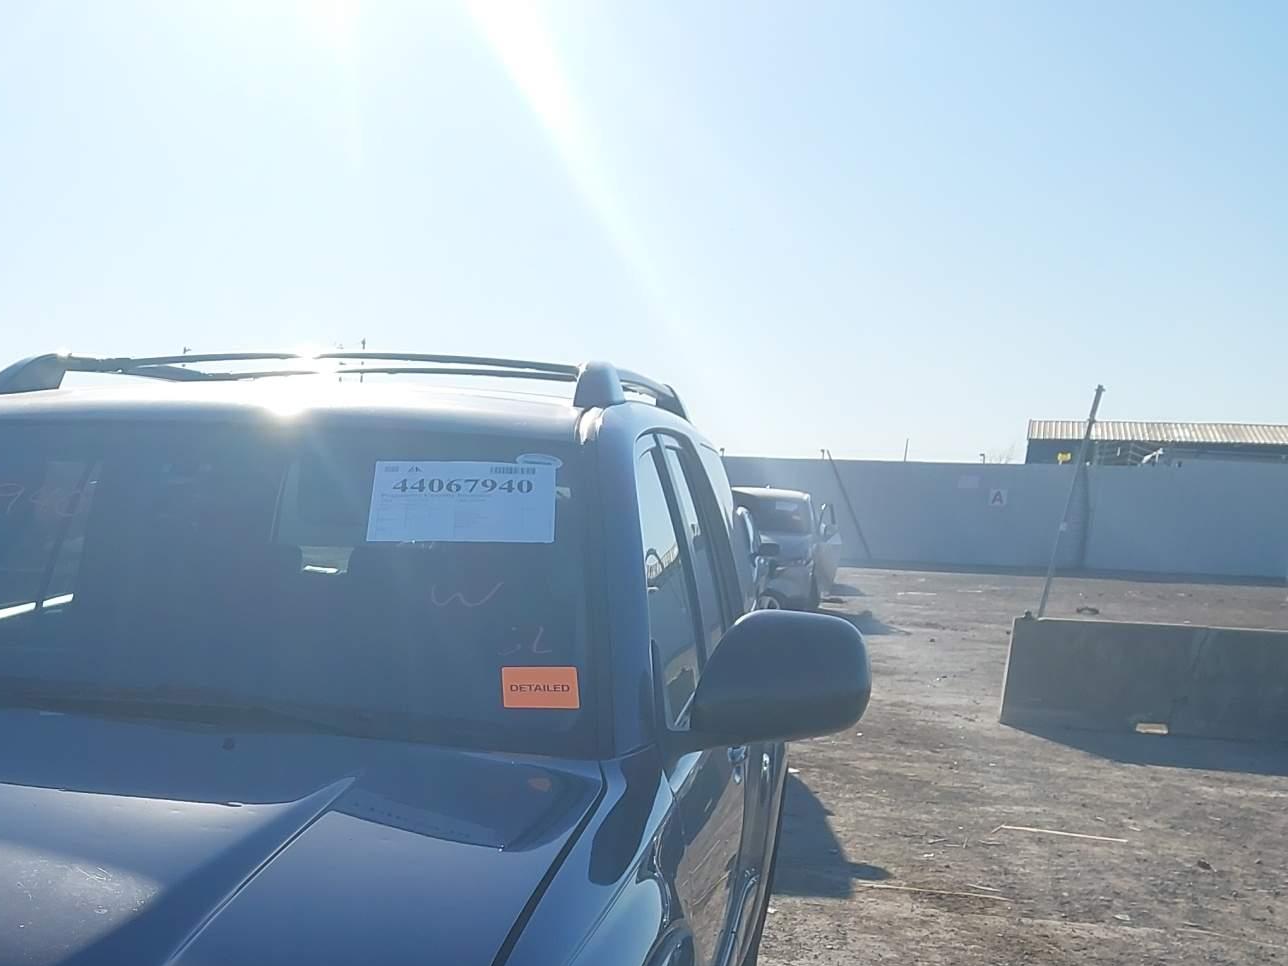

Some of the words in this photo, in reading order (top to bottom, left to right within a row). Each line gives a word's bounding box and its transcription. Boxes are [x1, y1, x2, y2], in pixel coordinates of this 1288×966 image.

[392, 478, 533, 494] 44067940
[991, 491, 1004, 504] A
[510, 684, 571, 692] DETAILED
